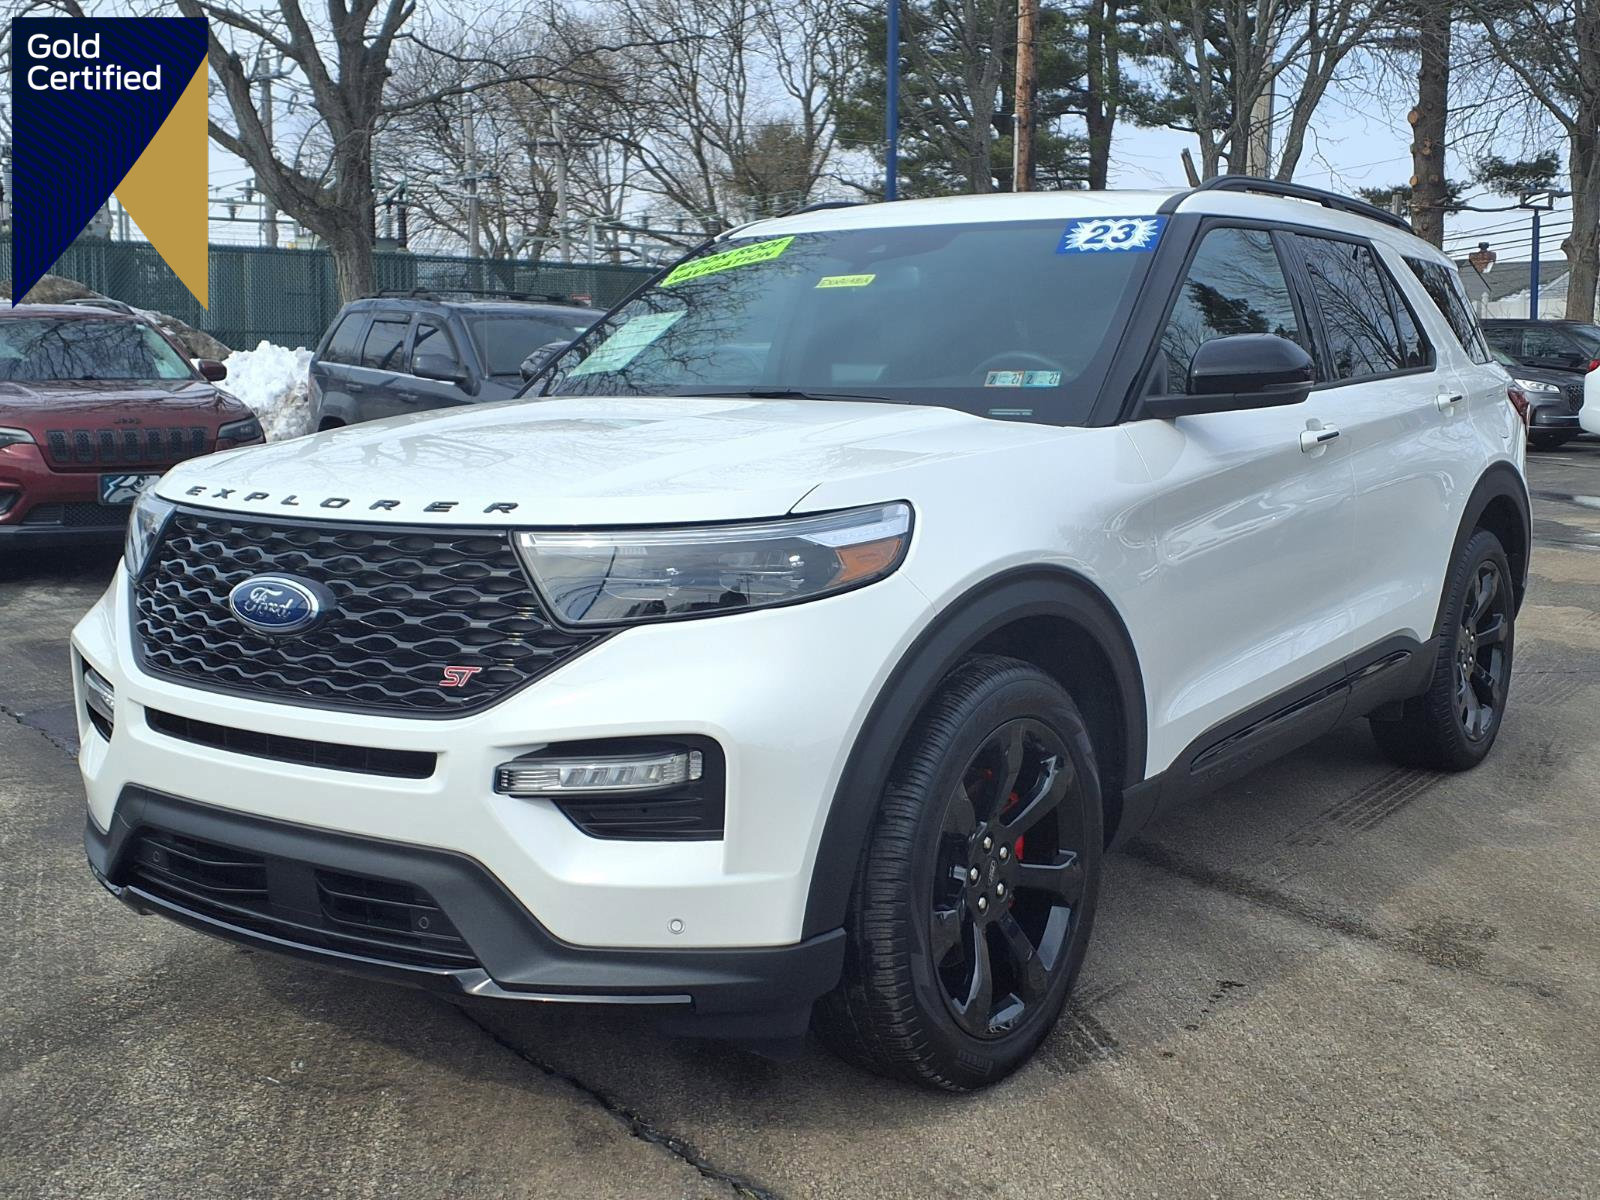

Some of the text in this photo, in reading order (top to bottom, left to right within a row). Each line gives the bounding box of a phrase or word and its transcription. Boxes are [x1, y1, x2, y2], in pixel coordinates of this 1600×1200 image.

[1083, 223, 1137, 245] 23
[669, 250, 775, 282] NAVIGATION
[185, 485, 520, 514] EXPLORER
[244, 586, 295, 618] Ford
[439, 665, 483, 687] ST
